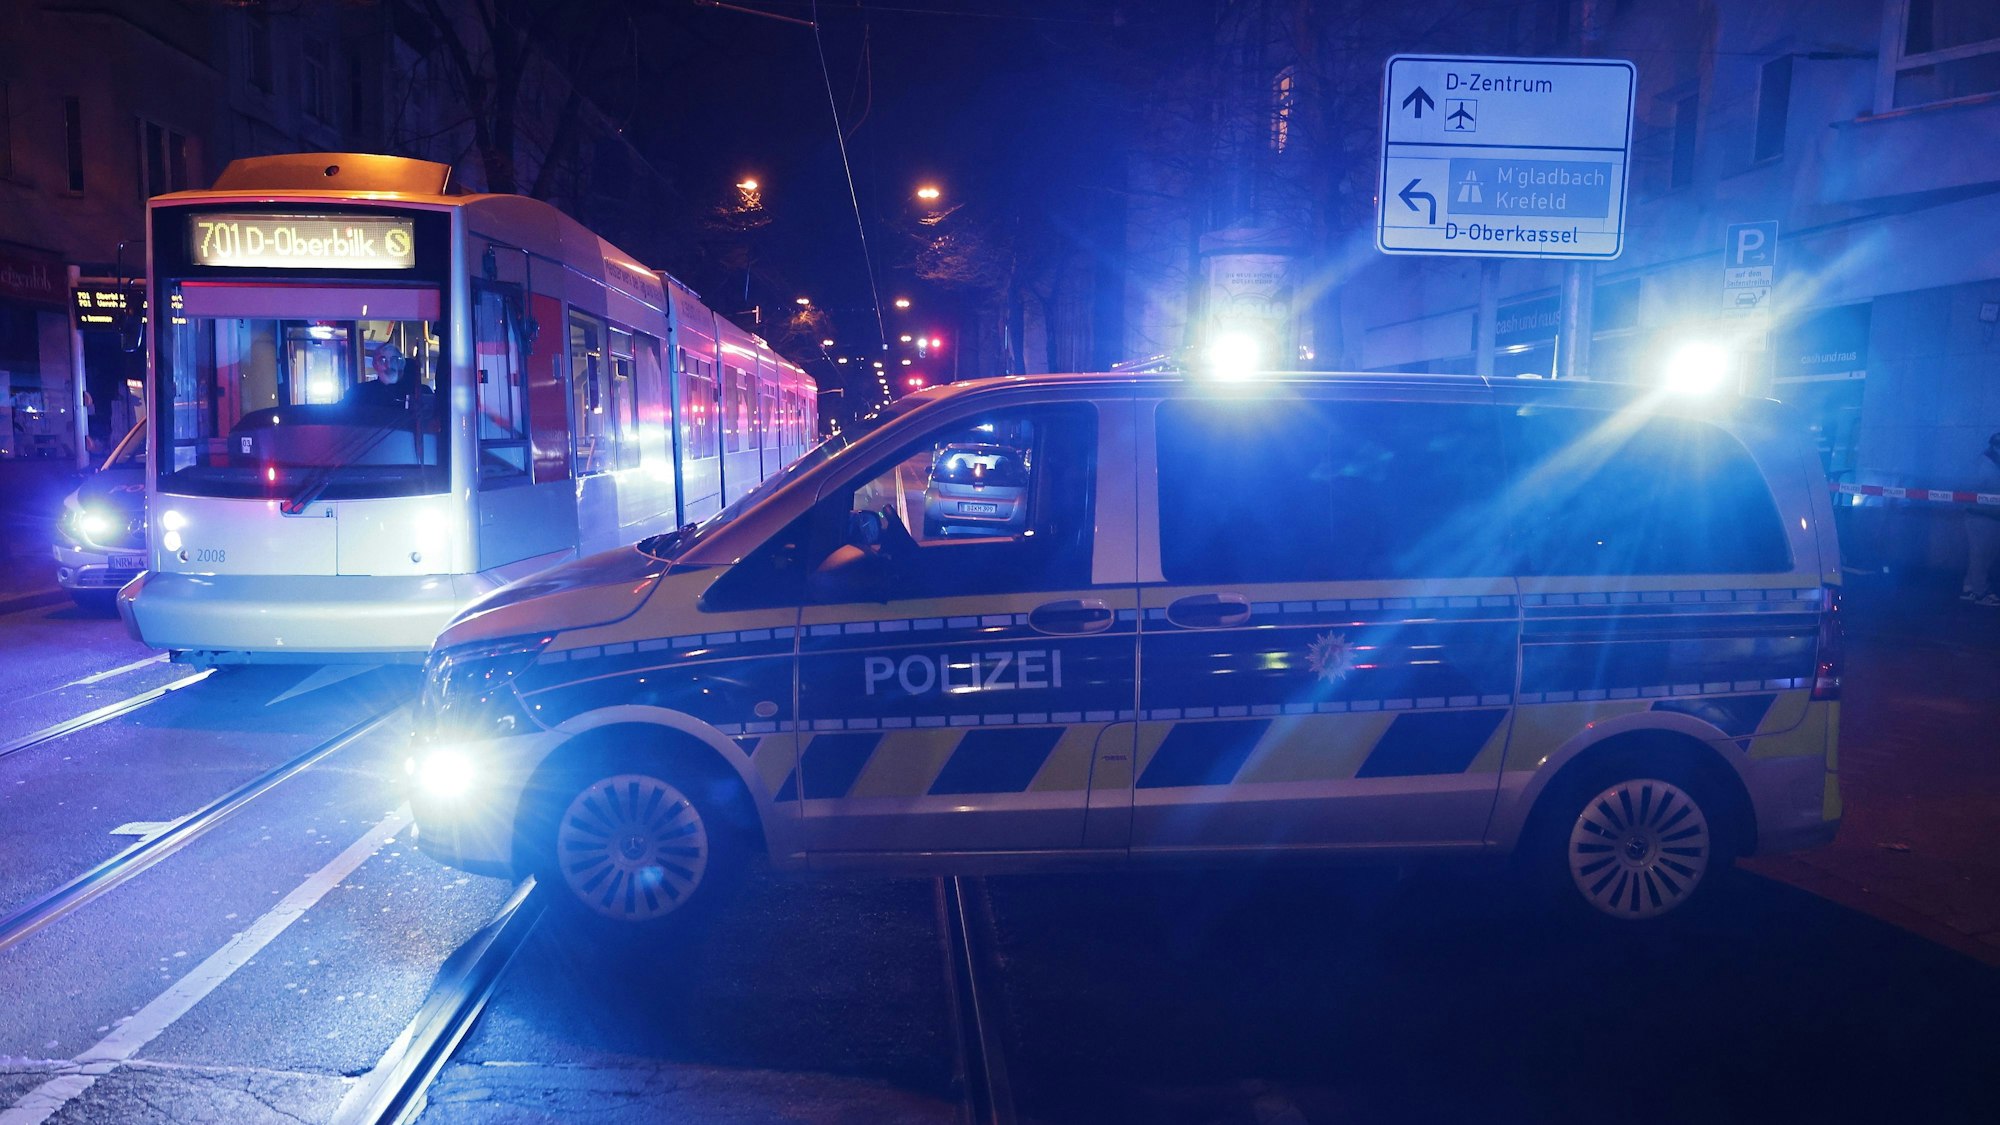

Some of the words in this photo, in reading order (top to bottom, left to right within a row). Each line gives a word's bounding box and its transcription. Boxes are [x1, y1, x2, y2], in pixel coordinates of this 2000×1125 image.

[1446, 73, 1552, 93] D-Zentrum
[1498, 167, 1604, 188] M'gladbach
[1496, 191, 1567, 210] Krefeld
[198, 222, 240, 258] 701
[246, 227, 377, 257] D-Oberbilk
[1445, 222, 1578, 244] D-Oberkassel
[1736, 229, 1764, 264] P
[1519, 309, 1537, 330] und
[1837, 351, 1857, 361] raus
[115, 557, 133, 568] NRW
[197, 549, 226, 563] 2008
[864, 649, 1062, 695] POLIZEI
